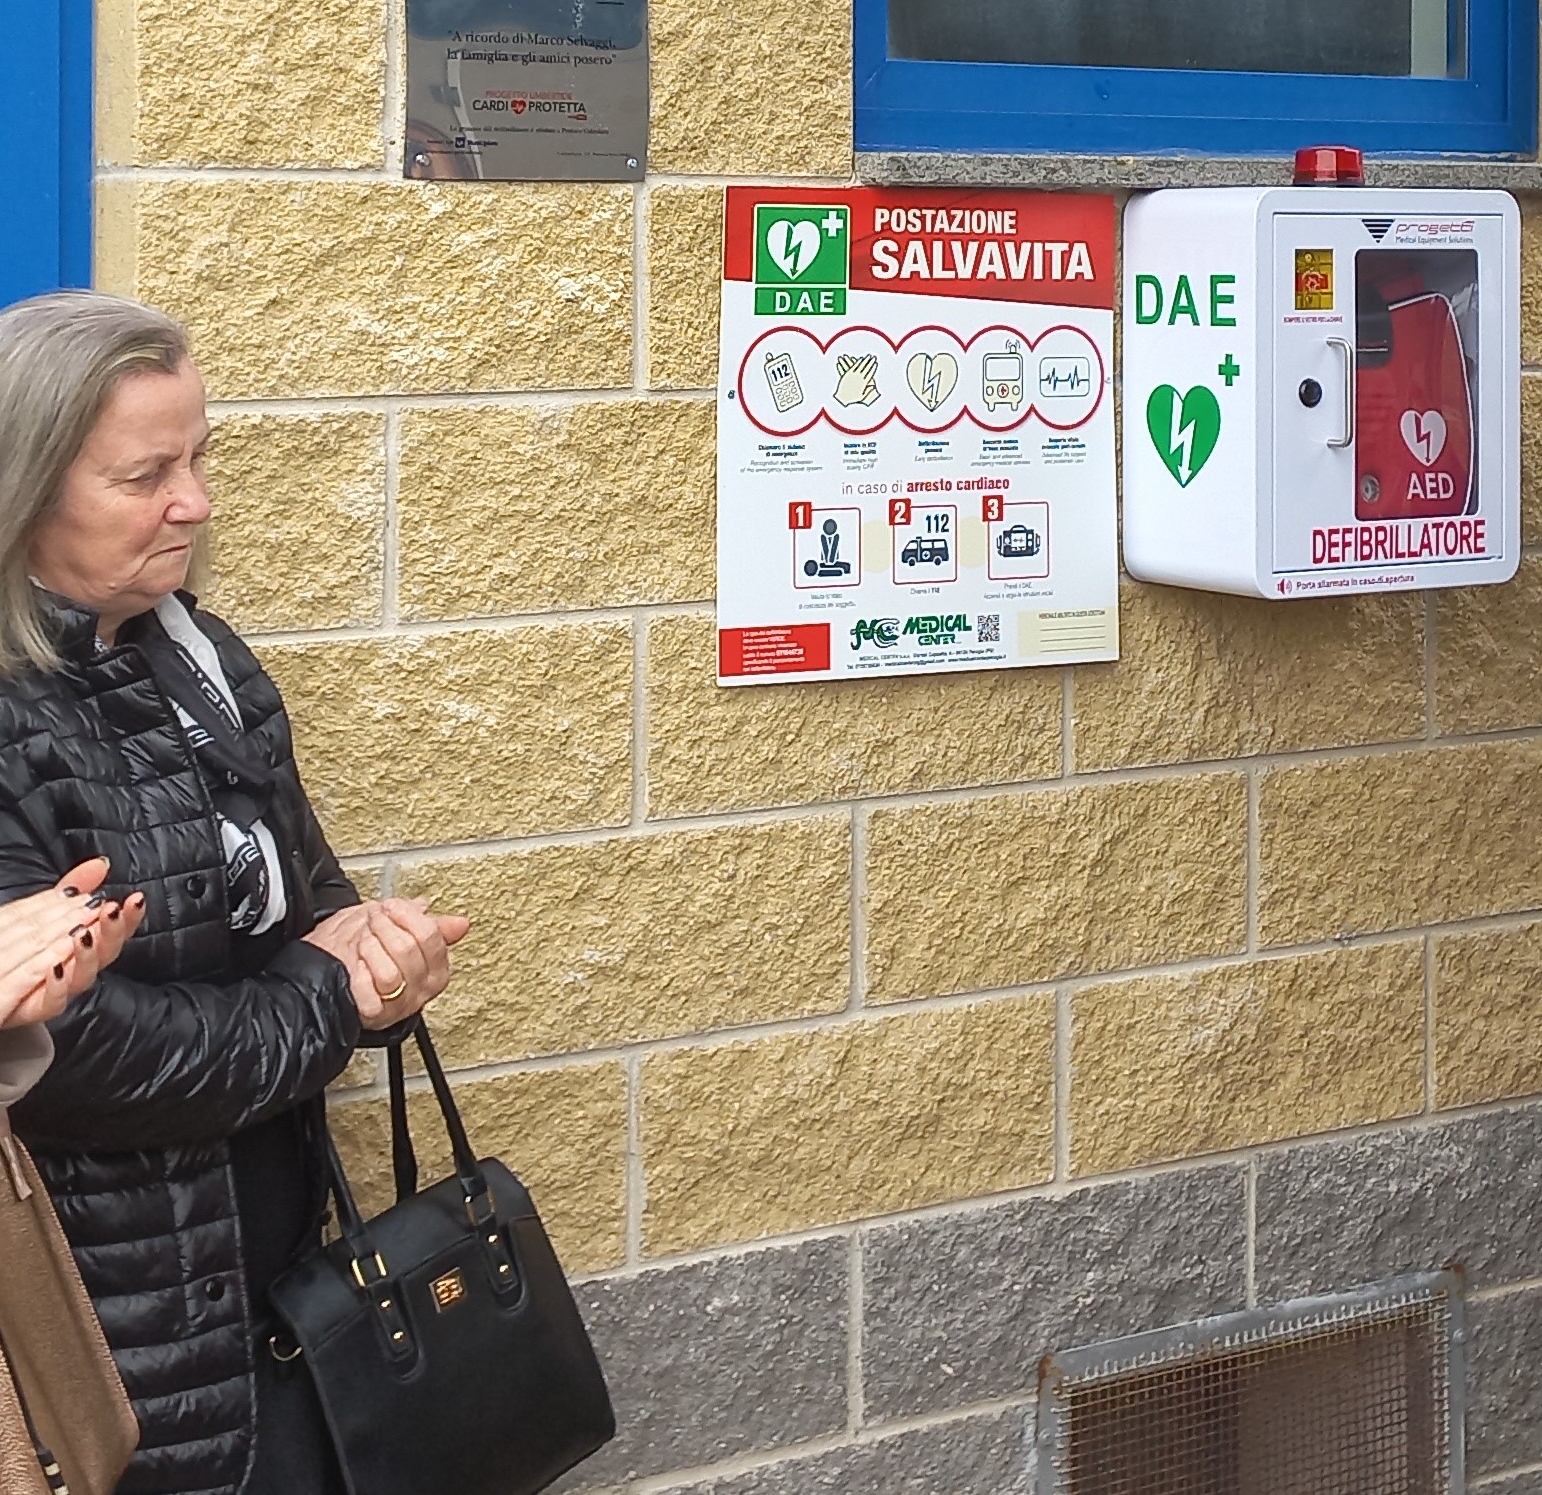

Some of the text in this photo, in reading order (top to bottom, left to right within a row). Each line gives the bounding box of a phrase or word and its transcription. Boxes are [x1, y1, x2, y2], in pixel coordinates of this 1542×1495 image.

[465, 31, 509, 44] ricordo
[512, 32, 524, 44] di
[528, 33, 563, 45] Marco
[460, 49, 508, 65] famiglia
[521, 51, 536, 66] gli
[539, 52, 570, 64] amici
[472, 99, 586, 113] CARDI PROTETTA
[874, 208, 1017, 234] POSTAZIONE
[872, 239, 1095, 280] SALVAVITA
[774, 291, 834, 313] DAE
[1135, 274, 1237, 327] DAE
[772, 364, 790, 382] 112
[842, 477, 1010, 495] in caso di arresto cardiaco
[1407, 472, 1455, 500] AED
[795, 505, 804, 527] 1
[894, 502, 907, 523] 2
[987, 499, 999, 519] 3
[925, 514, 950, 533] 112
[1312, 518, 1486, 565] DEFIBRILLATORE
[902, 614, 972, 635] MEDICAL
[918, 634, 956, 646] CENTER
